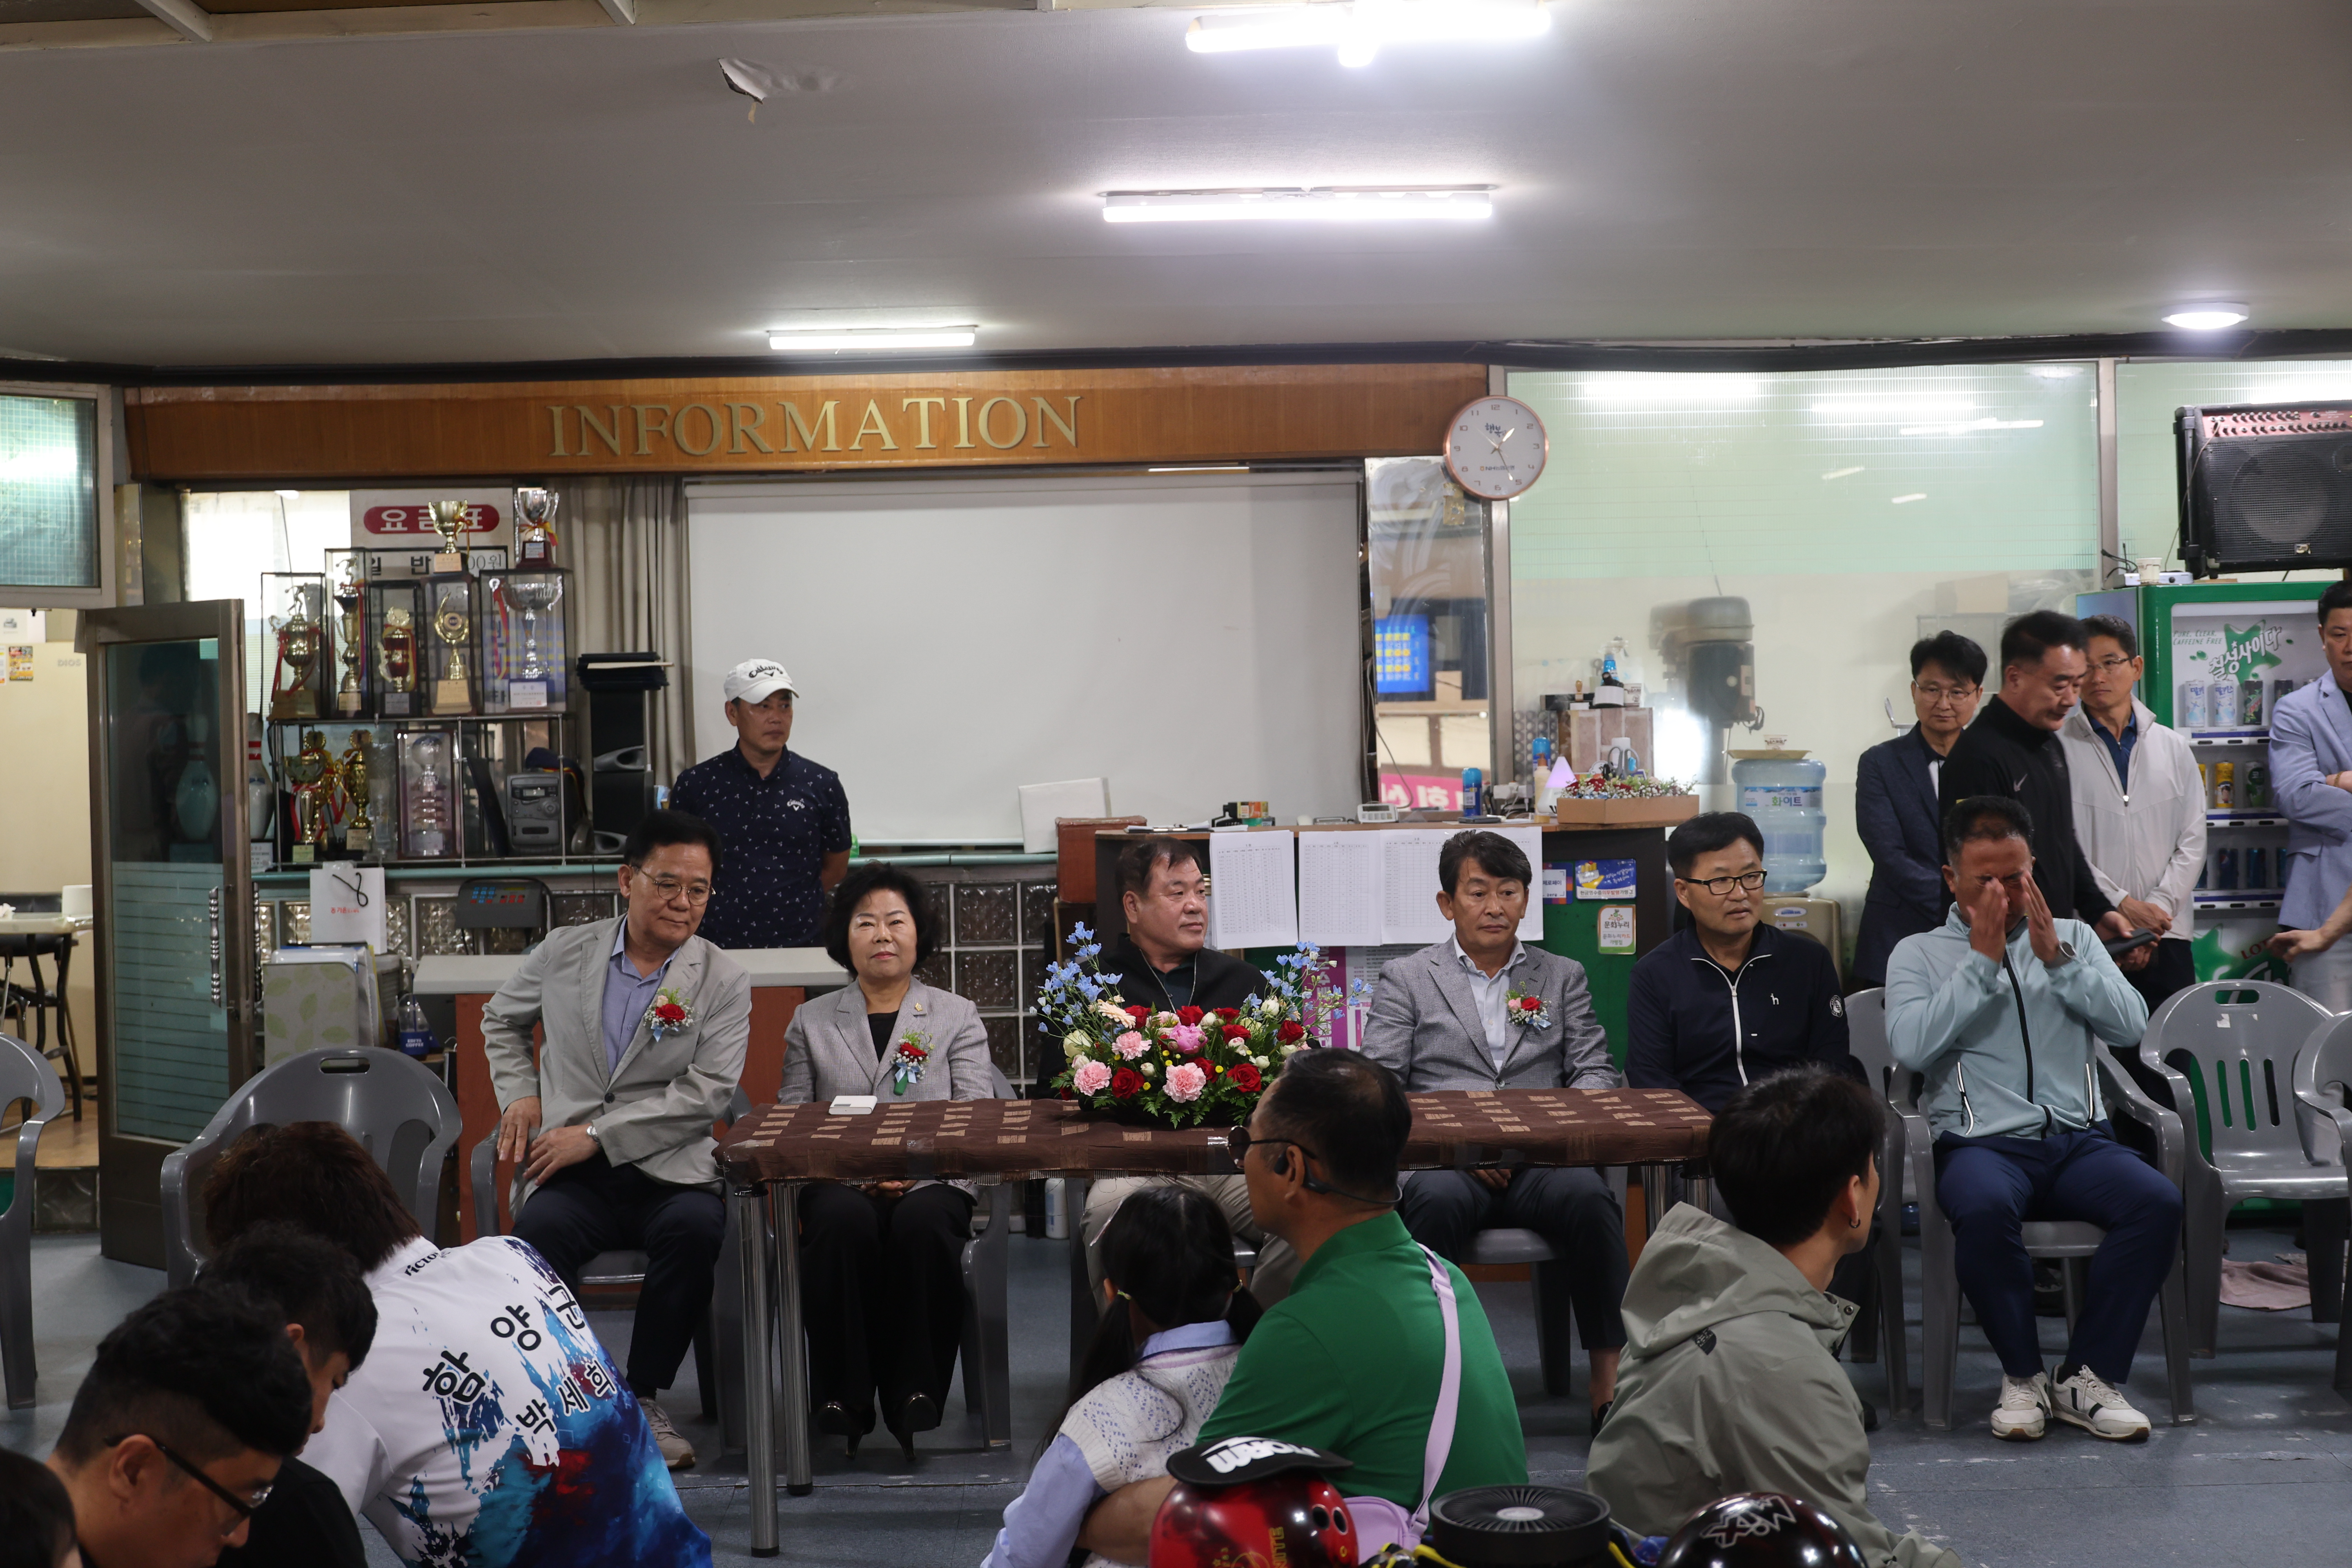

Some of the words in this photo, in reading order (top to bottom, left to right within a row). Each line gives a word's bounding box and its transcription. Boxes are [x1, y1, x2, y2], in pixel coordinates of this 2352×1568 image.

[548, 396, 1082, 456] INFORMATION
[2209, 626, 2282, 681] 칠성사이다
[1772, 796, 1802, 807] 화이트
[1604, 920, 1629, 929] 문화누리
